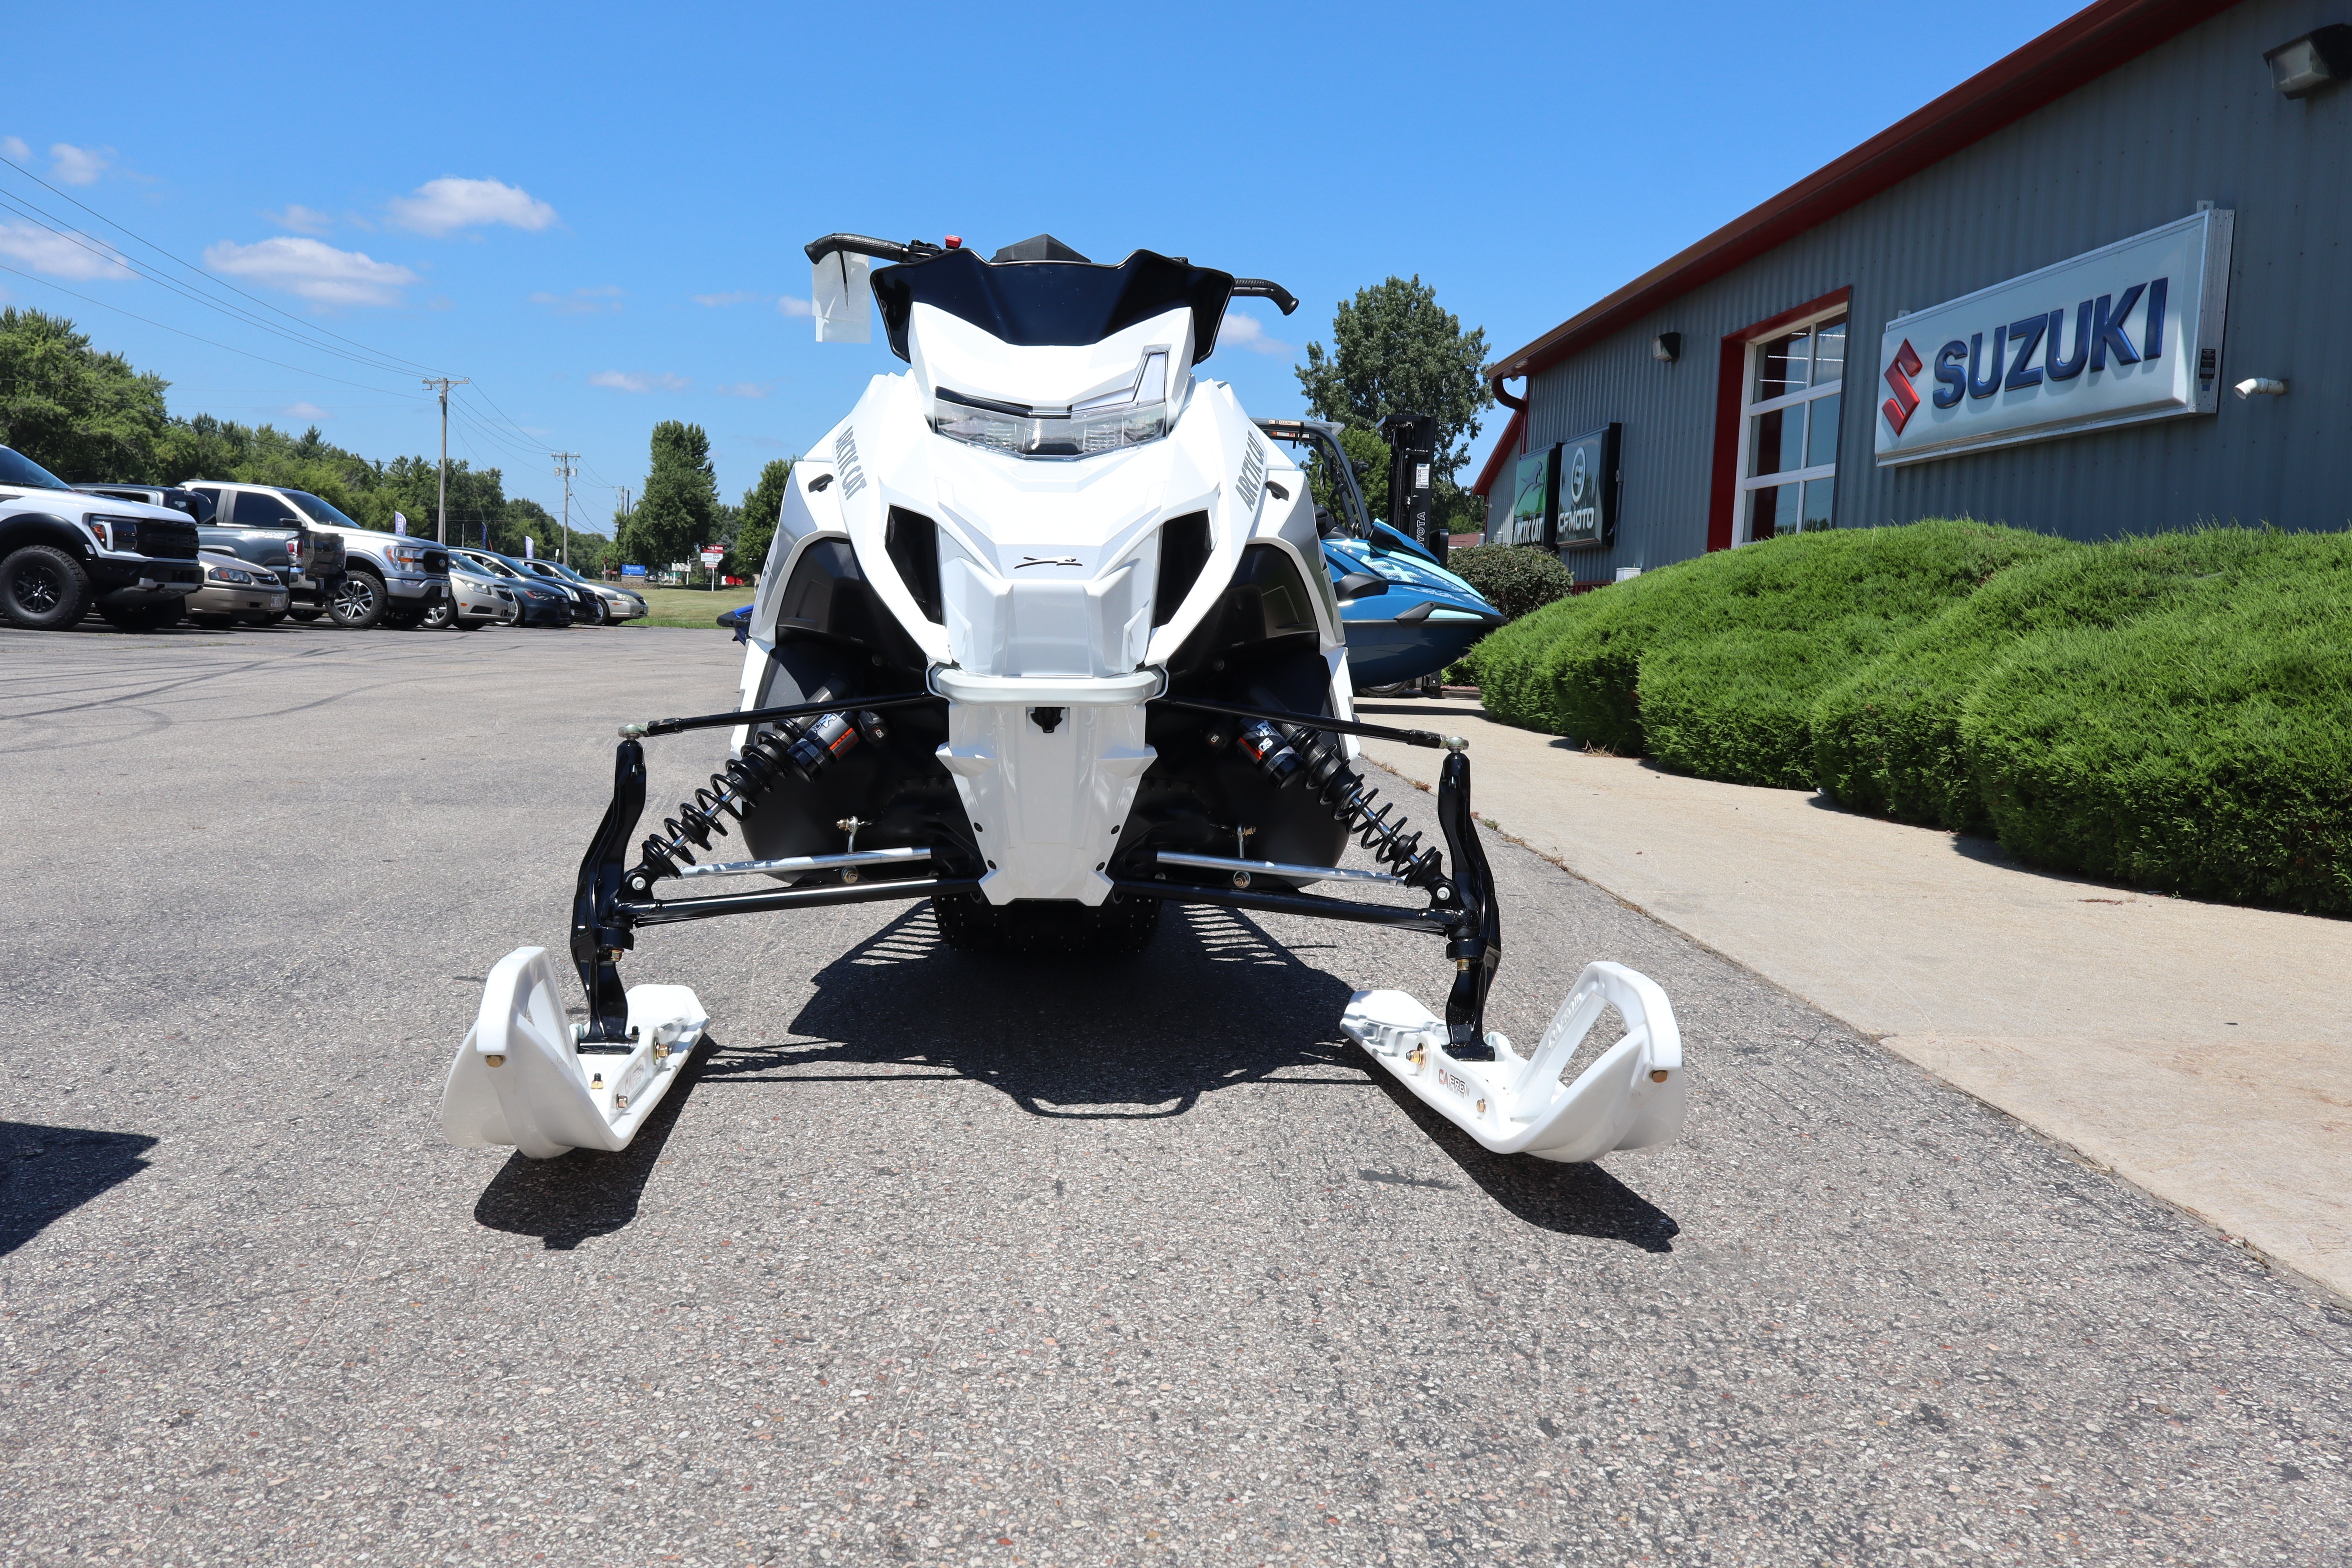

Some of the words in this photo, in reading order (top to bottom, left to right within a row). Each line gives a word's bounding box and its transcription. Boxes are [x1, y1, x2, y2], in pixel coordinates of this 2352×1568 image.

[1933, 277, 2169, 409] SUZUKI
[836, 425, 858, 477] ARCTIC
[1247, 430, 1264, 465] CAT
[842, 465, 867, 501] CAT
[1235, 449, 1262, 513] ARCTIC
[1416, 511, 1426, 548] YOTA
[1513, 519, 1531, 545] ARCTIC
[1531, 517, 1543, 542] CAT
[1558, 507, 1594, 534] CFMOTO
